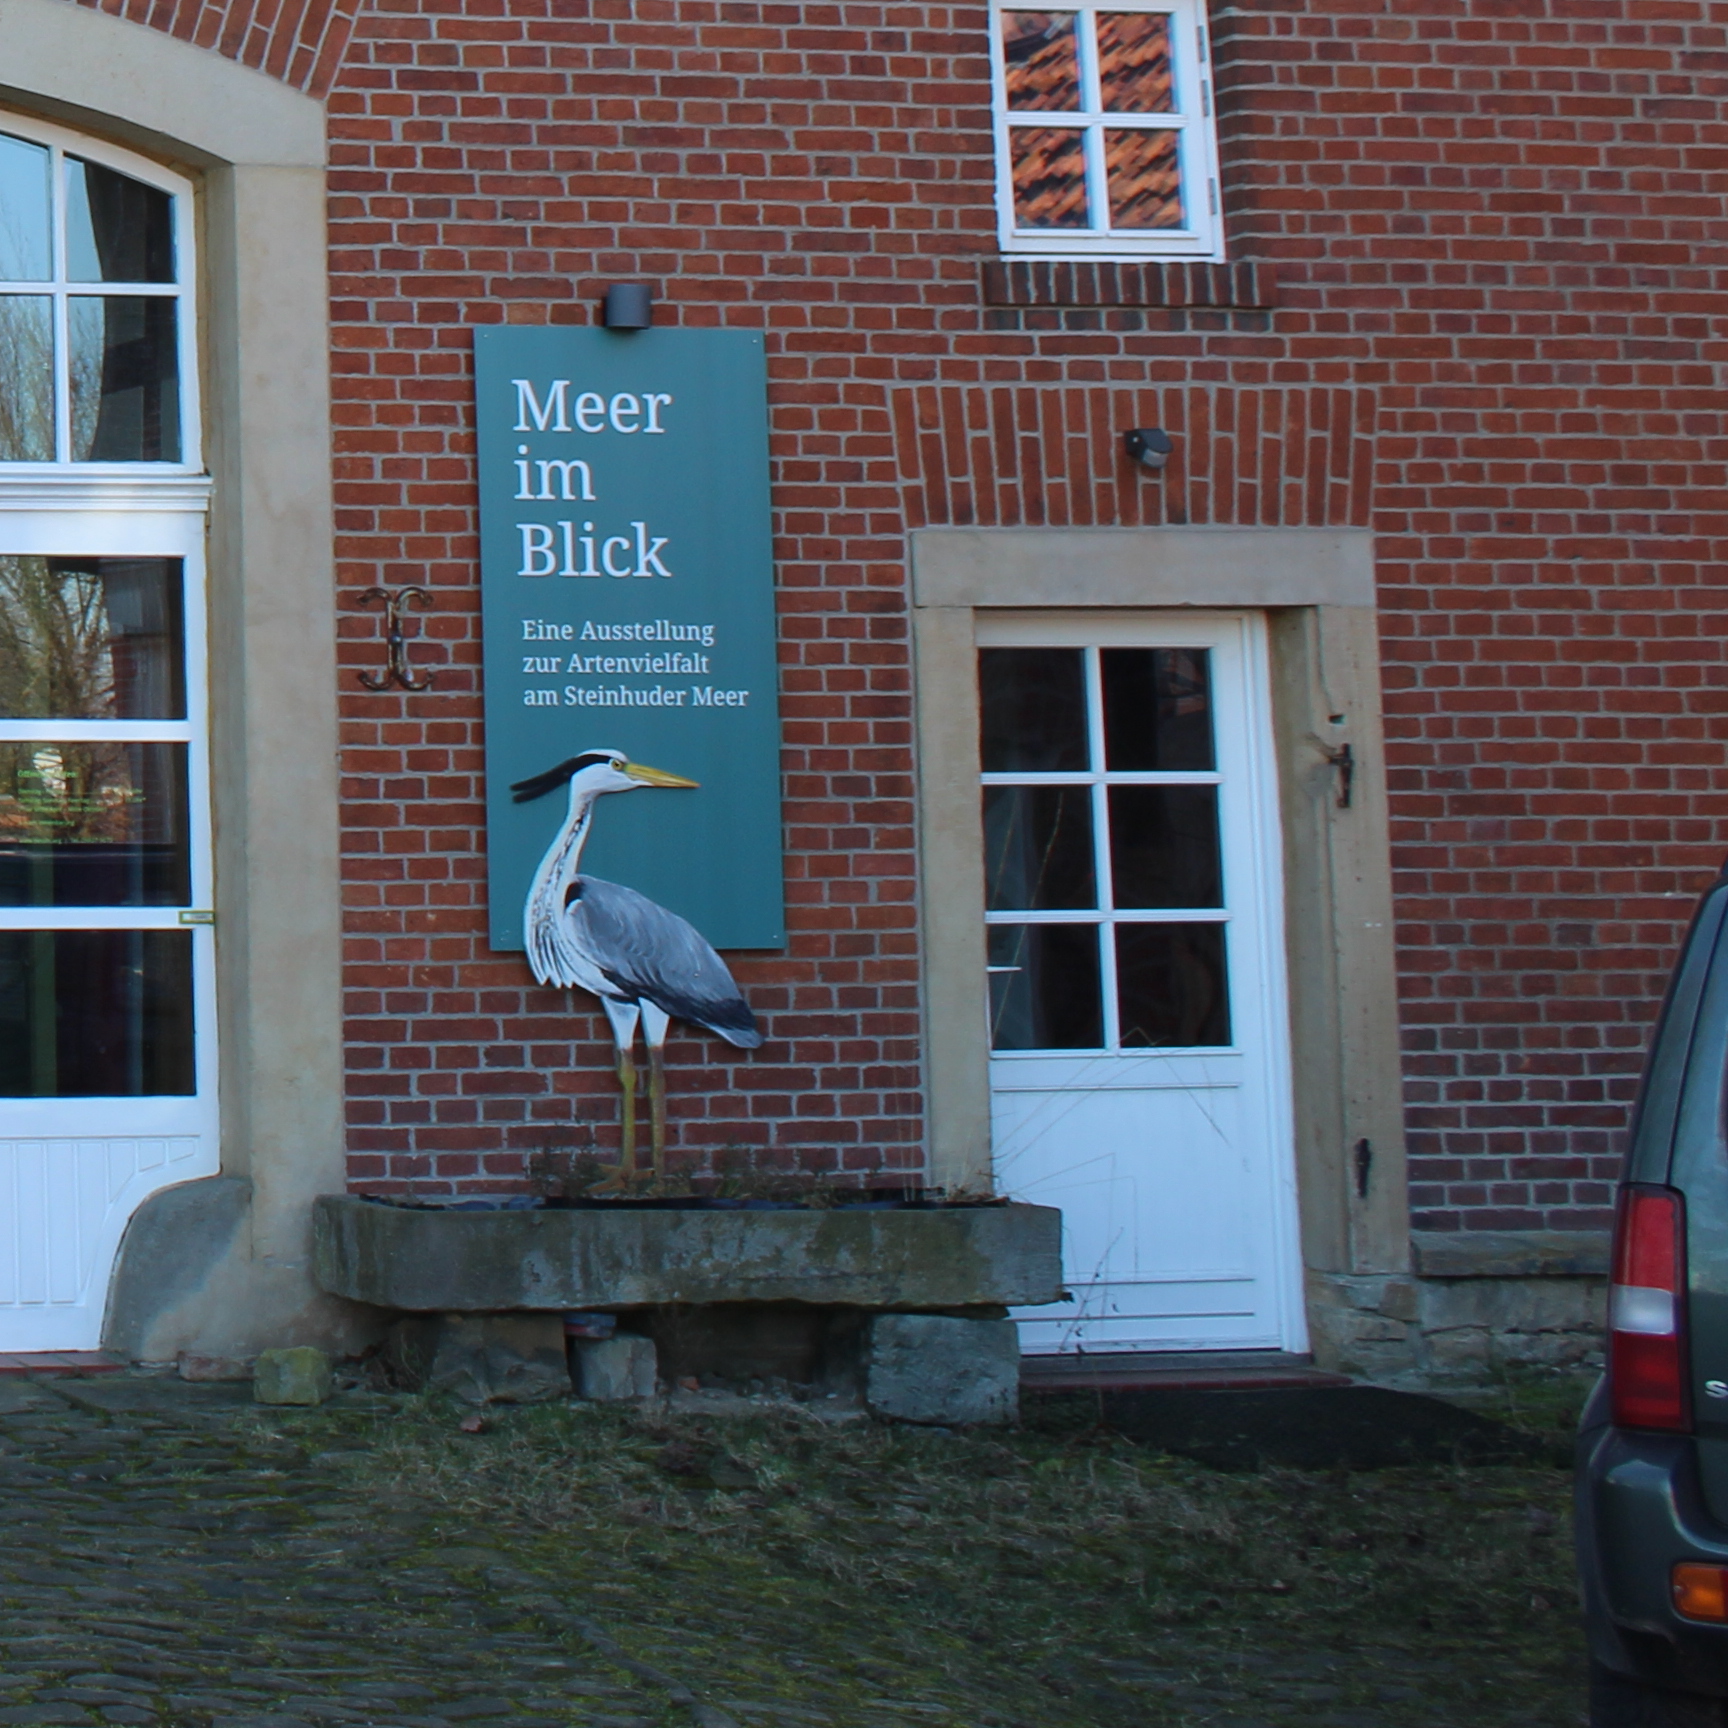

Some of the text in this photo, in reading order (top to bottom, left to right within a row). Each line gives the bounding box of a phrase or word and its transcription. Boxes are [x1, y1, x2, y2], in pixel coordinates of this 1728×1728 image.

[511, 379, 672, 433] Meer
[513, 444, 596, 501] im
[516, 521, 672, 578] Blick
[522, 619, 715, 647] Eine Ausstellung
[522, 652, 710, 673] zur Artenvielfalt
[523, 684, 749, 706] am Steinhuder Meer
